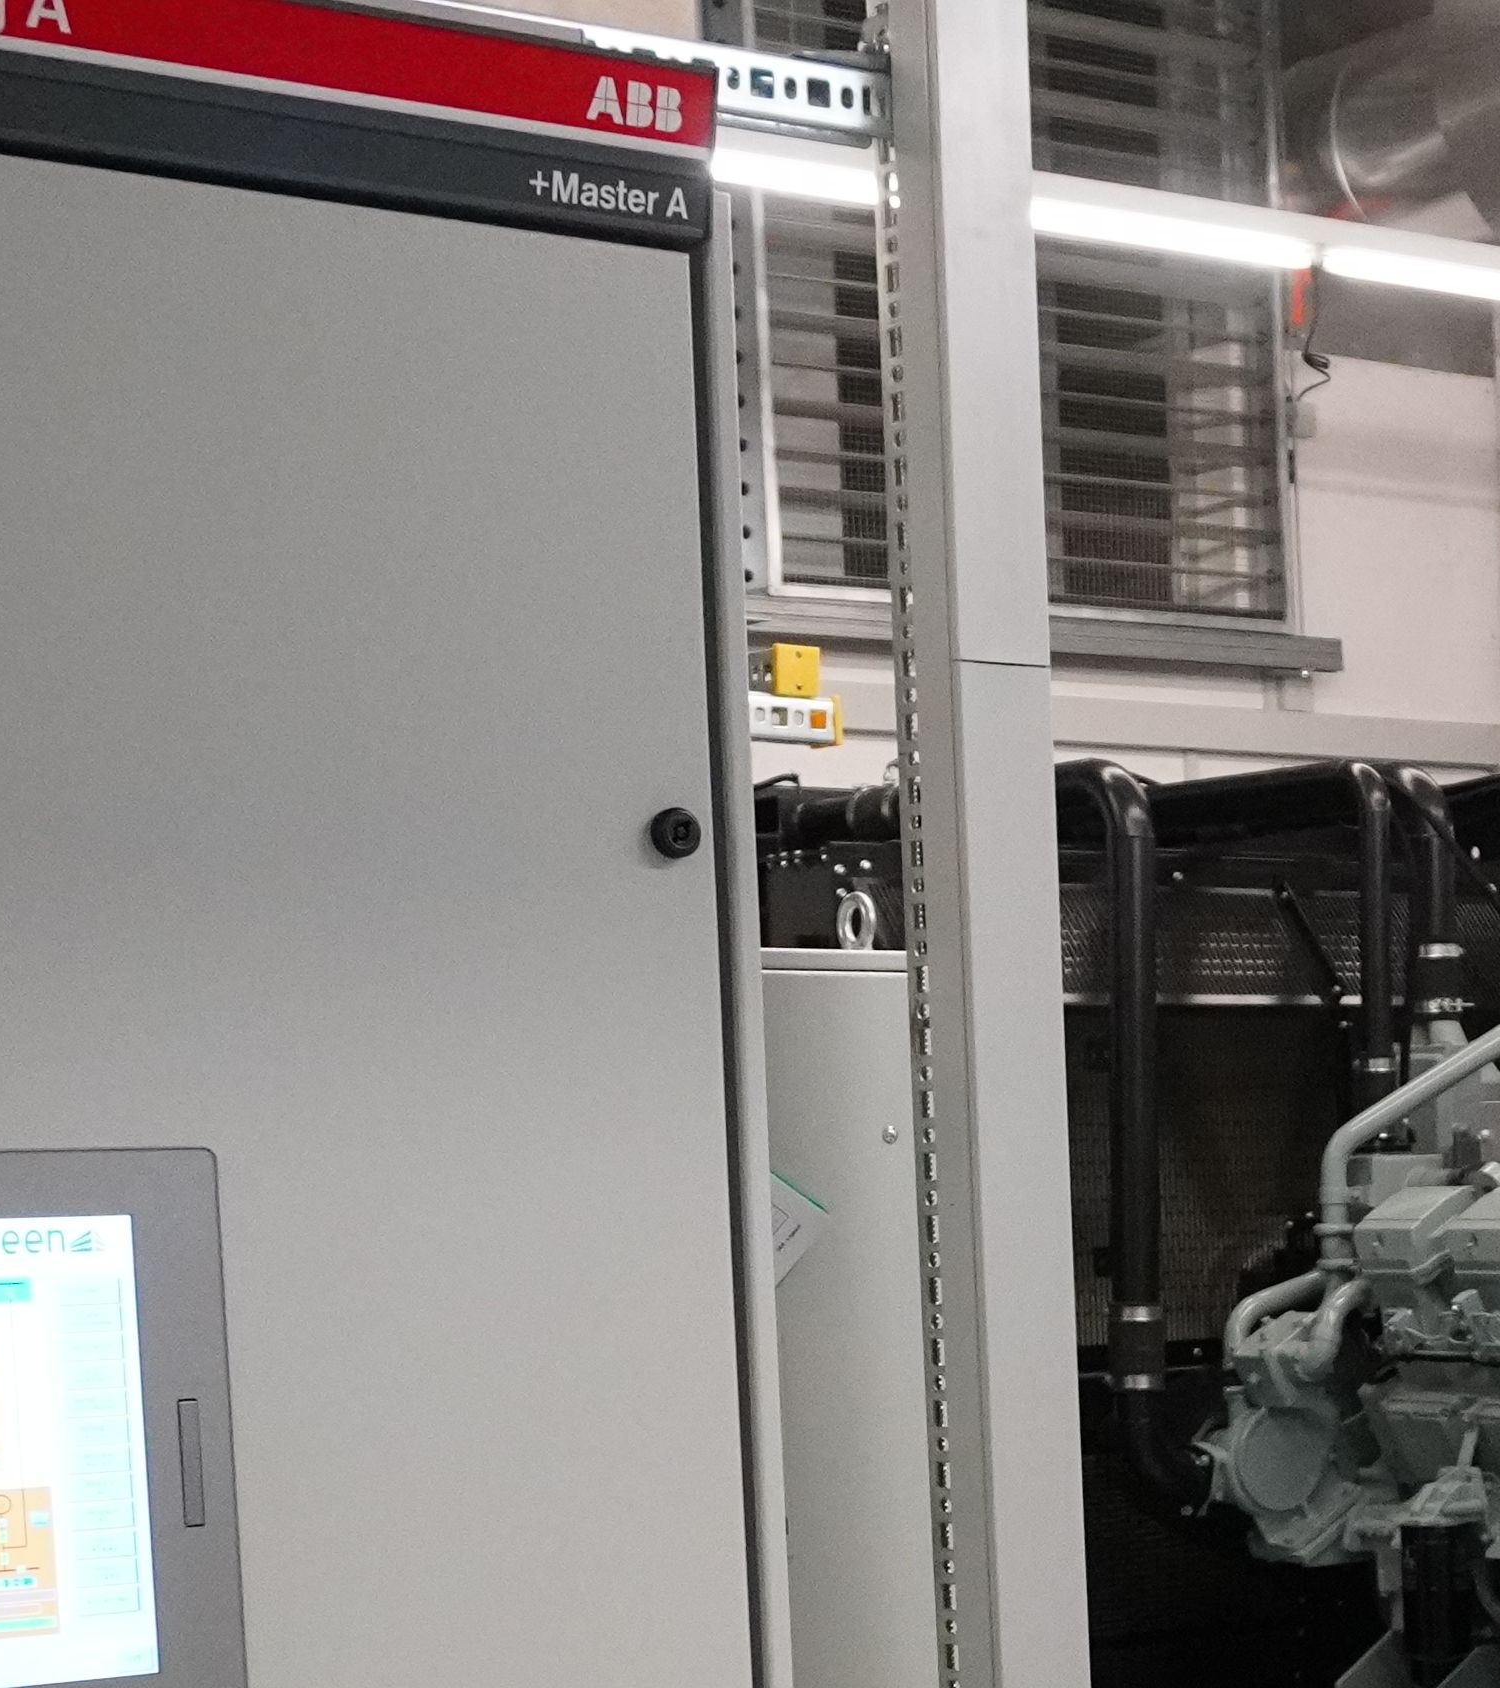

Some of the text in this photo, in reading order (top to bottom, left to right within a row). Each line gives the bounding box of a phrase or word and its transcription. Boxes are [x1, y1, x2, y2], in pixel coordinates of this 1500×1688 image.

[586, 76, 683, 132] ABB
[528, 170, 690, 220] +Master A
